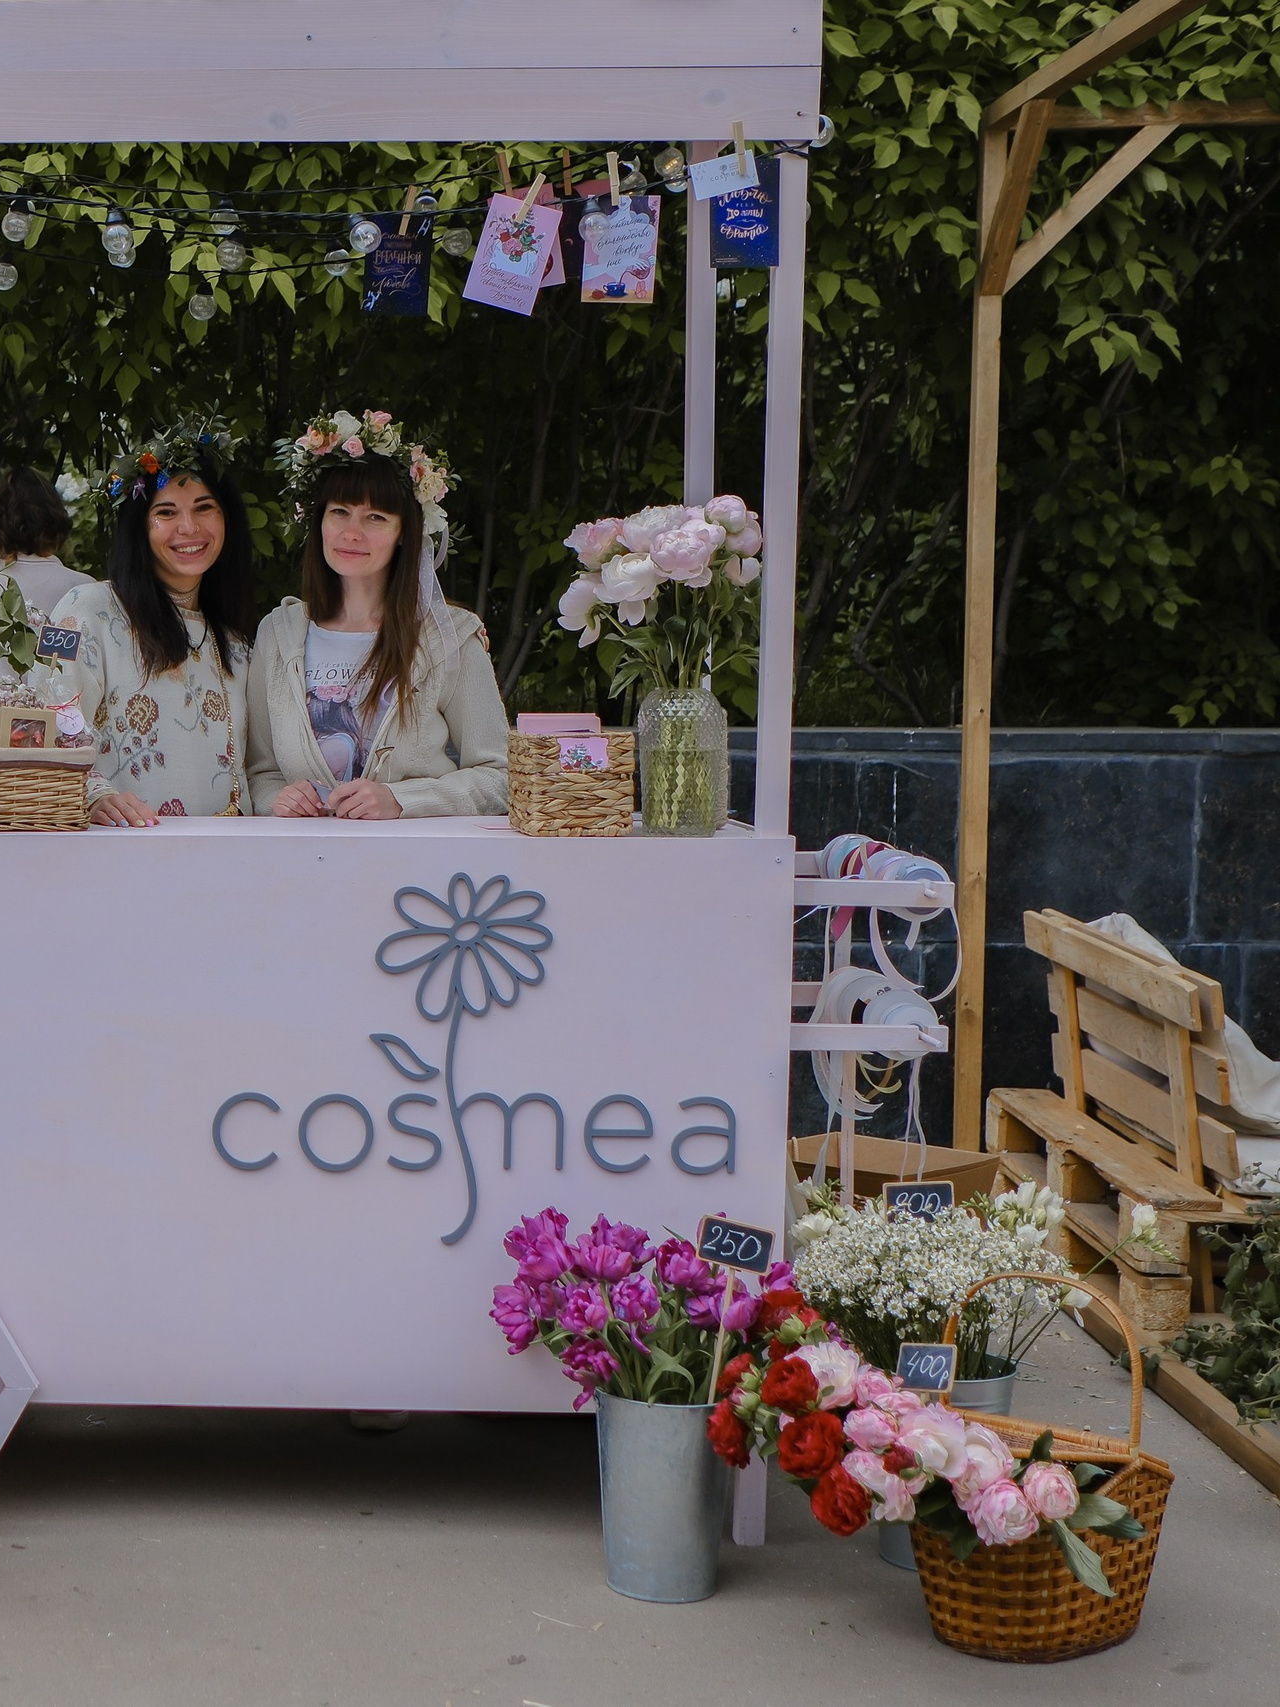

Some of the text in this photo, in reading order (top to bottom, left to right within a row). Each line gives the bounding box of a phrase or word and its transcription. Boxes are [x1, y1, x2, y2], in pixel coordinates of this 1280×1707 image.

[42, 631, 77, 649] 350
[212, 1091, 737, 1176] cosmea
[703, 1226, 762, 1261] 250
